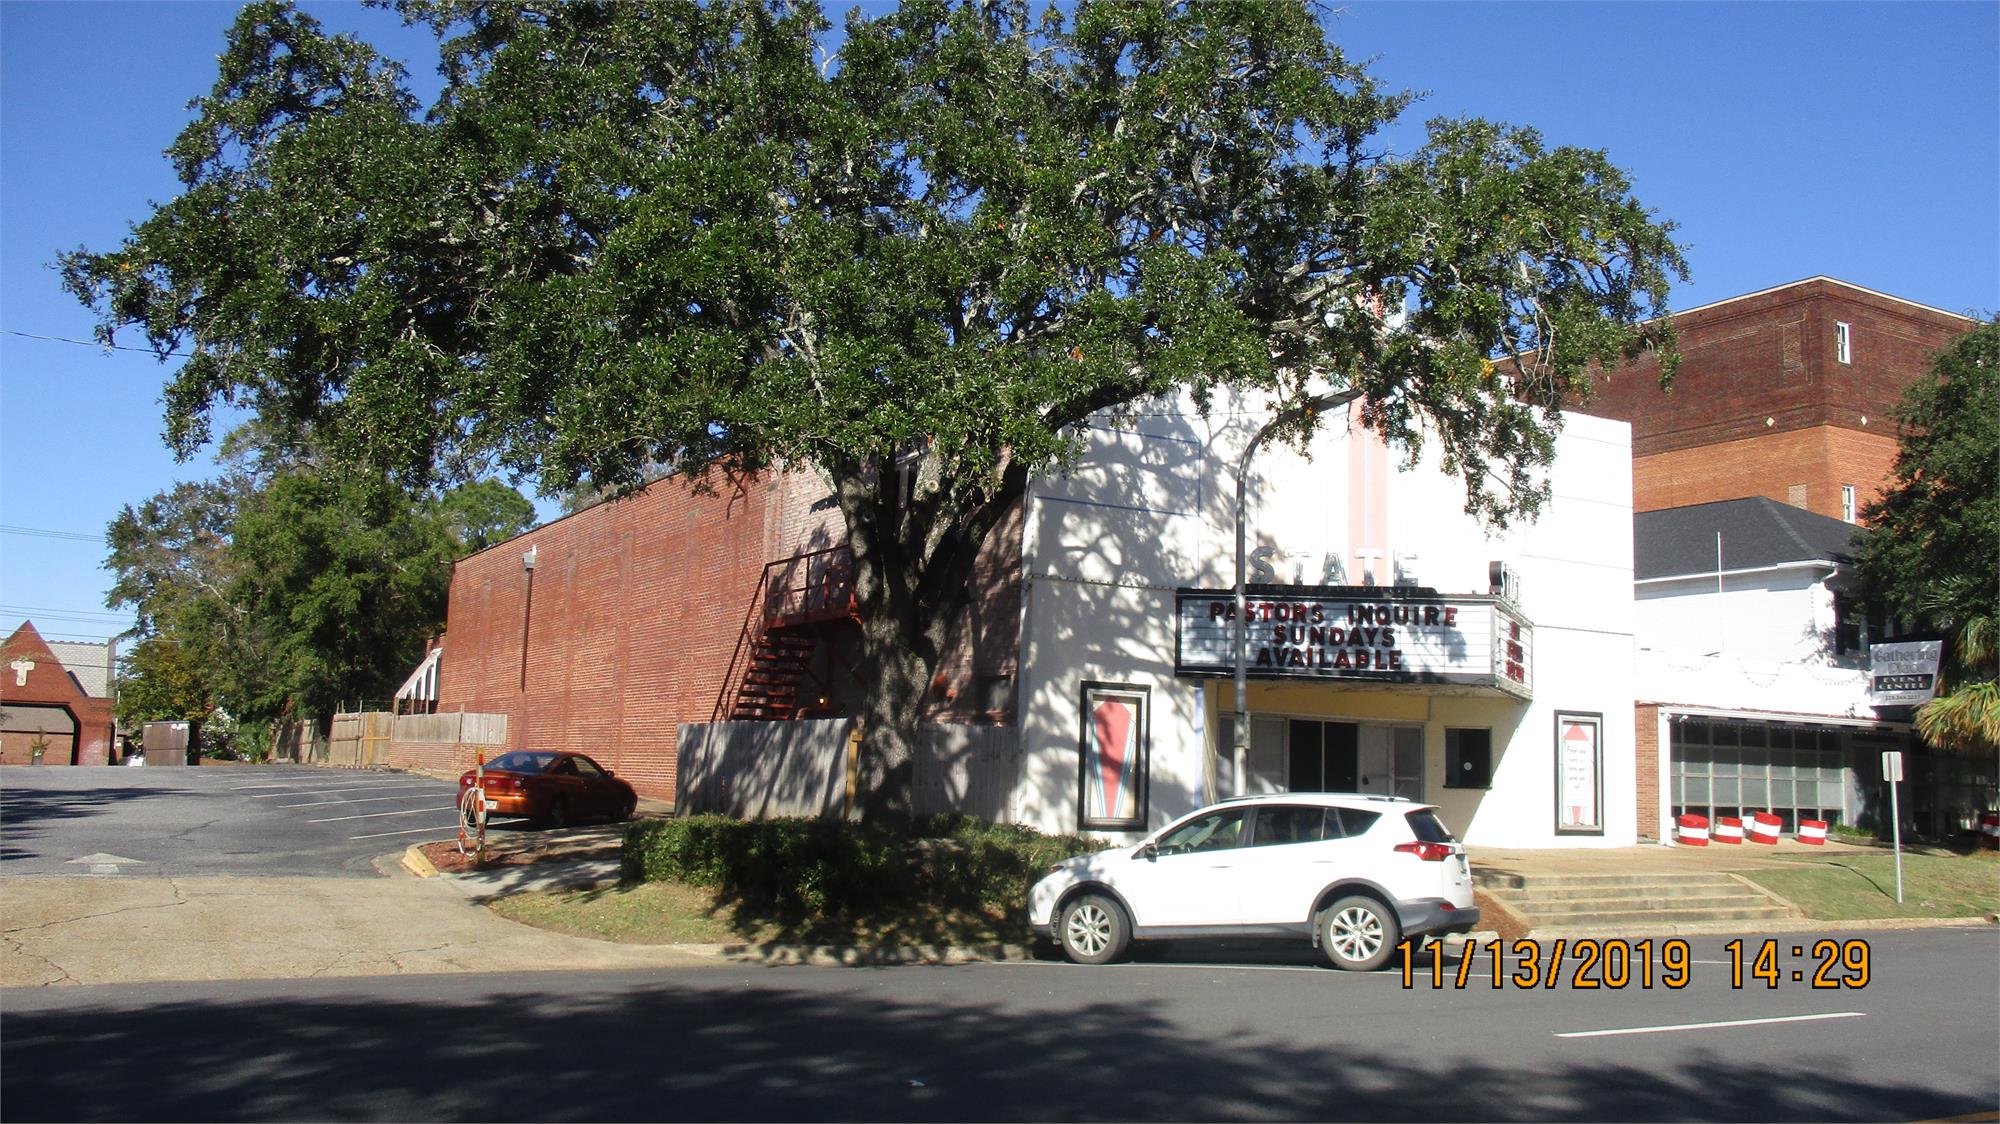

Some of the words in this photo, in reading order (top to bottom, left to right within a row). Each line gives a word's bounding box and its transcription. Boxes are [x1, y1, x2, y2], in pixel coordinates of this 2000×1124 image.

[1249, 546, 1419, 587] STATE
[1210, 602, 1324, 624] PASTORS
[1348, 604, 1458, 627] INQUIRE
[1273, 625, 1396, 647] SUNDAYS
[1256, 647, 1403, 671] AVAILABLE
